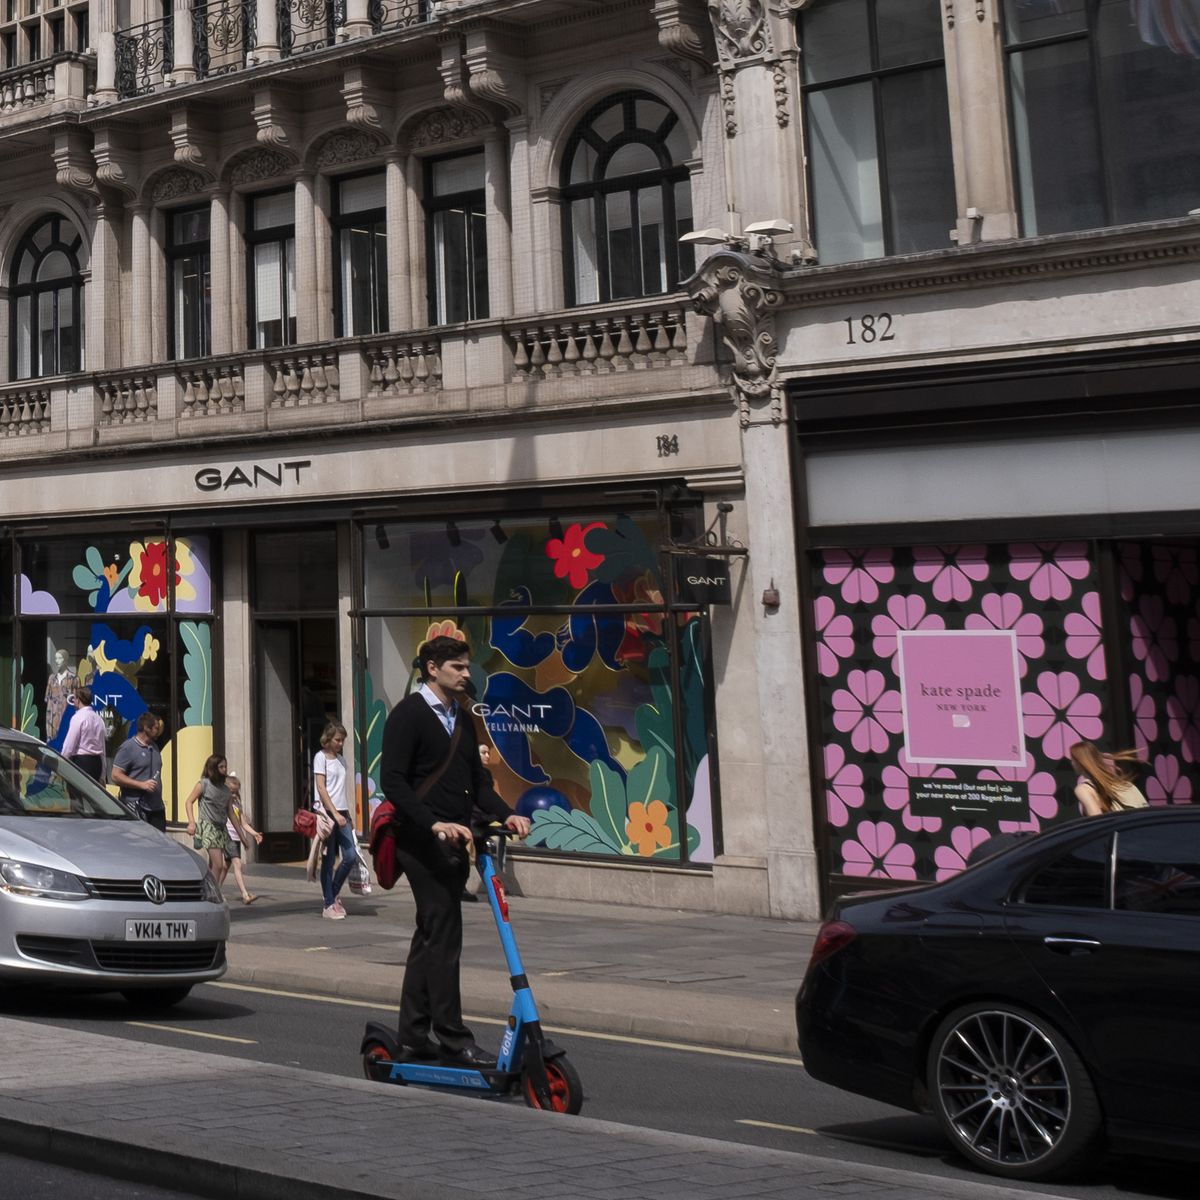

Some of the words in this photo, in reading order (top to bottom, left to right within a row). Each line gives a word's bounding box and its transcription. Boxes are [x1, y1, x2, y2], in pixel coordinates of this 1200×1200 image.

[844, 313, 895, 345] 182
[194, 460, 312, 492] GANT
[687, 576, 726, 586] GANT
[67, 694, 123, 707] GNT
[920, 683, 953, 697] kate
[956, 684, 1001, 701] spade
[471, 703, 552, 718] GANT
[134, 922, 162, 939] VK14
[166, 922, 189, 939] THV
[501, 1030, 514, 1056] dott
